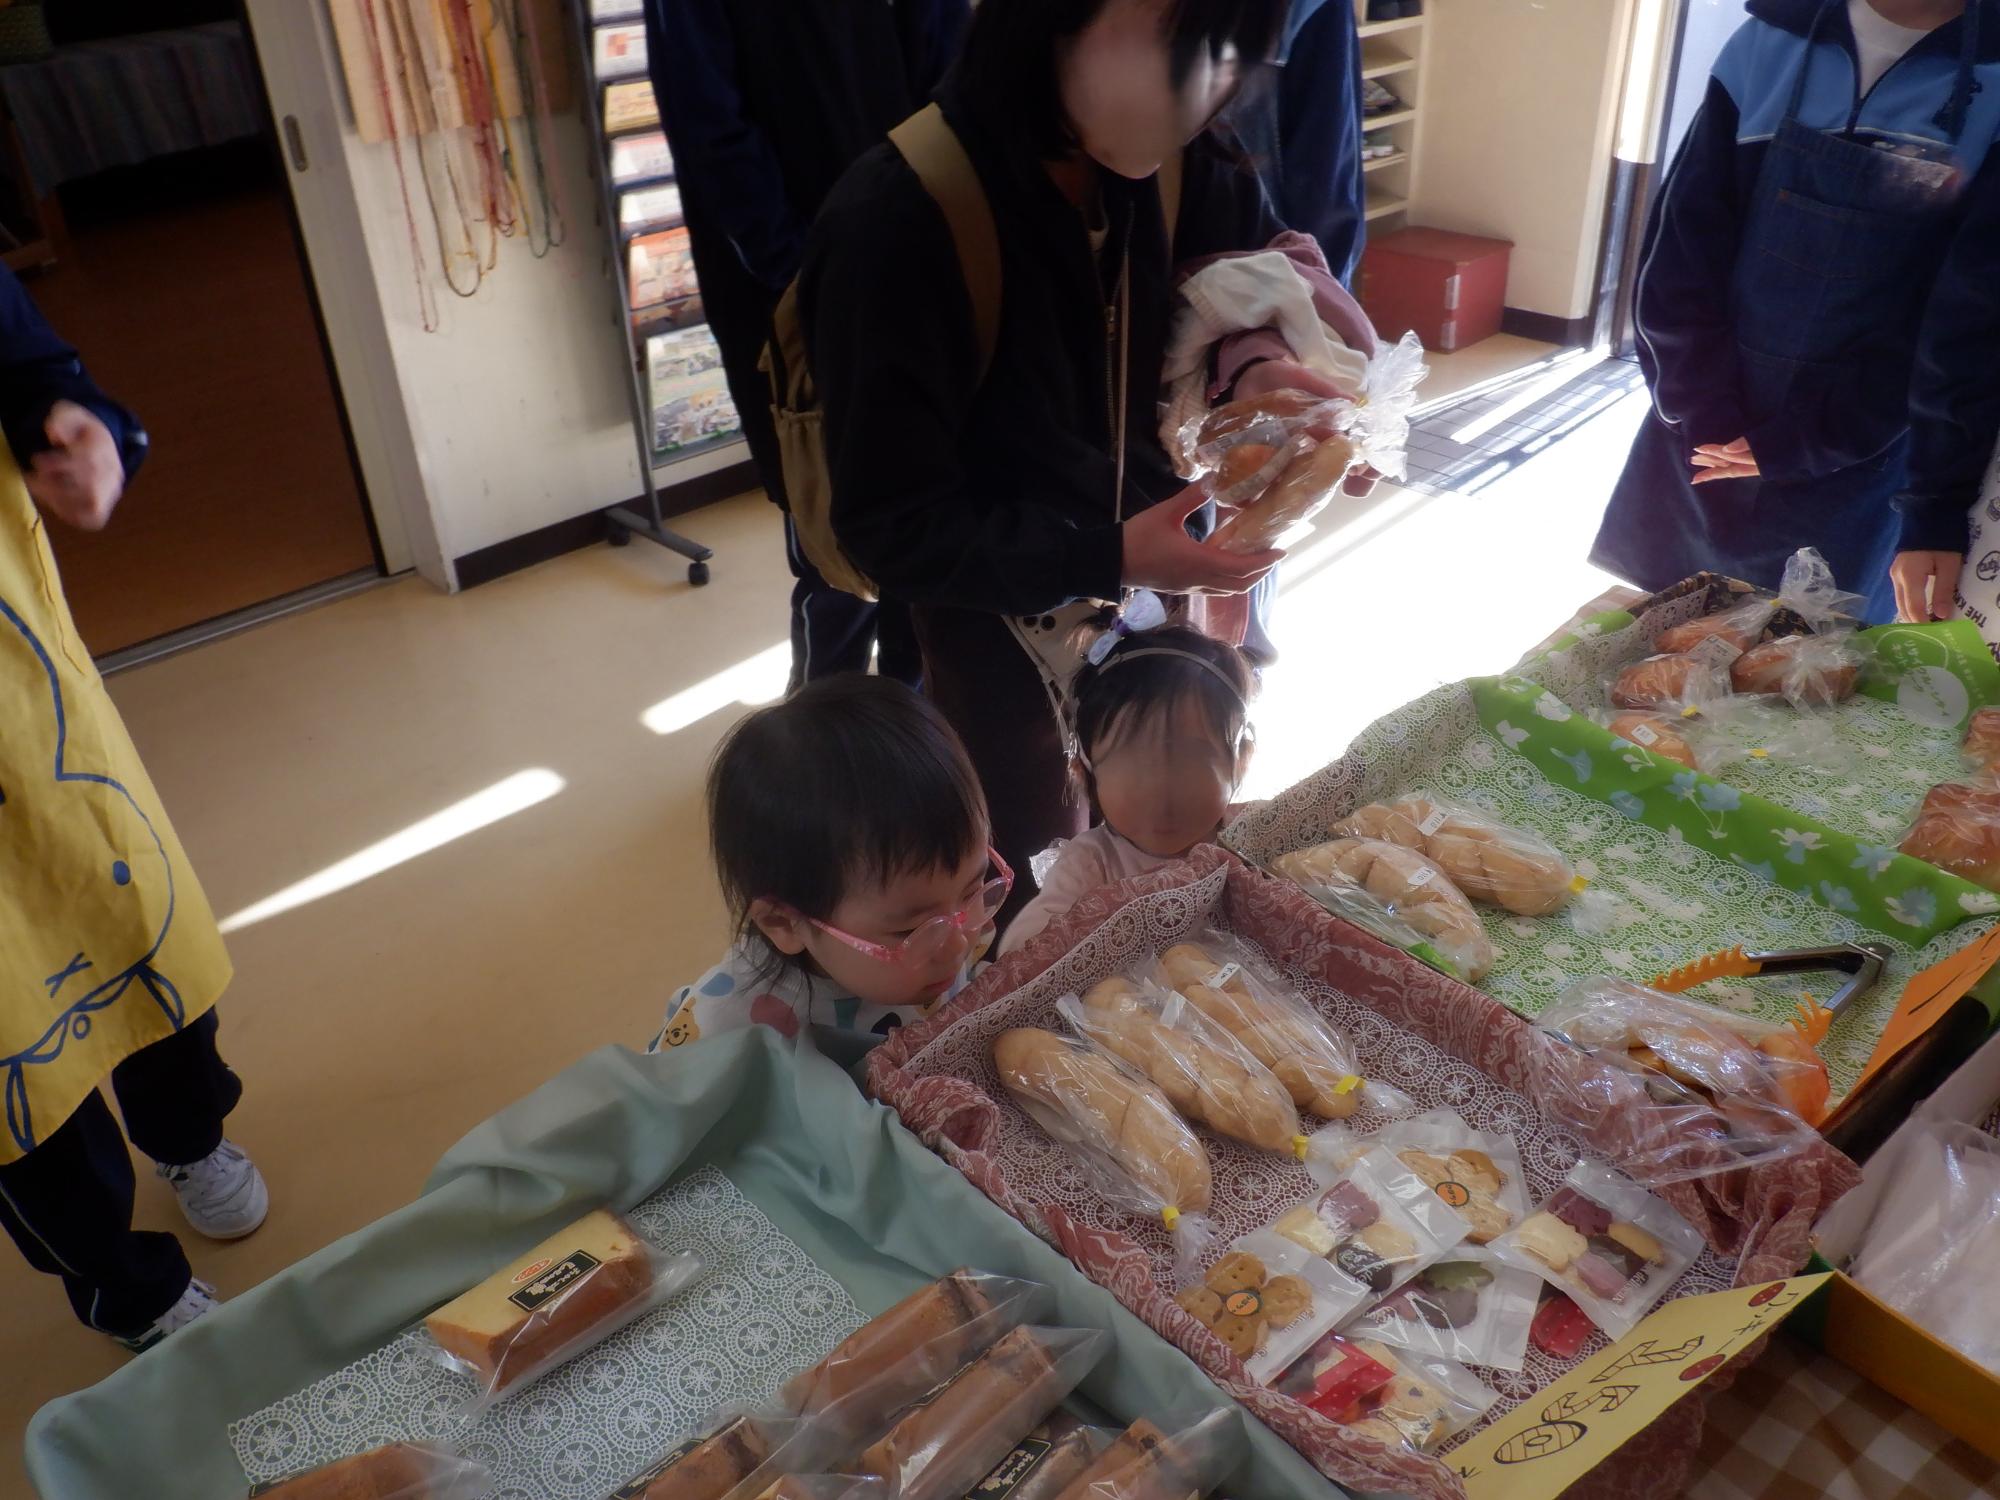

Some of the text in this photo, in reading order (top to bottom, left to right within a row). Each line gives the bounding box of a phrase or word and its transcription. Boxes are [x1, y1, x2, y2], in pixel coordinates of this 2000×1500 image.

[1965, 606, 1987, 627] THE
[1716, 1291, 1799, 1353] クッキー
[1494, 1335, 1705, 1465] 150
